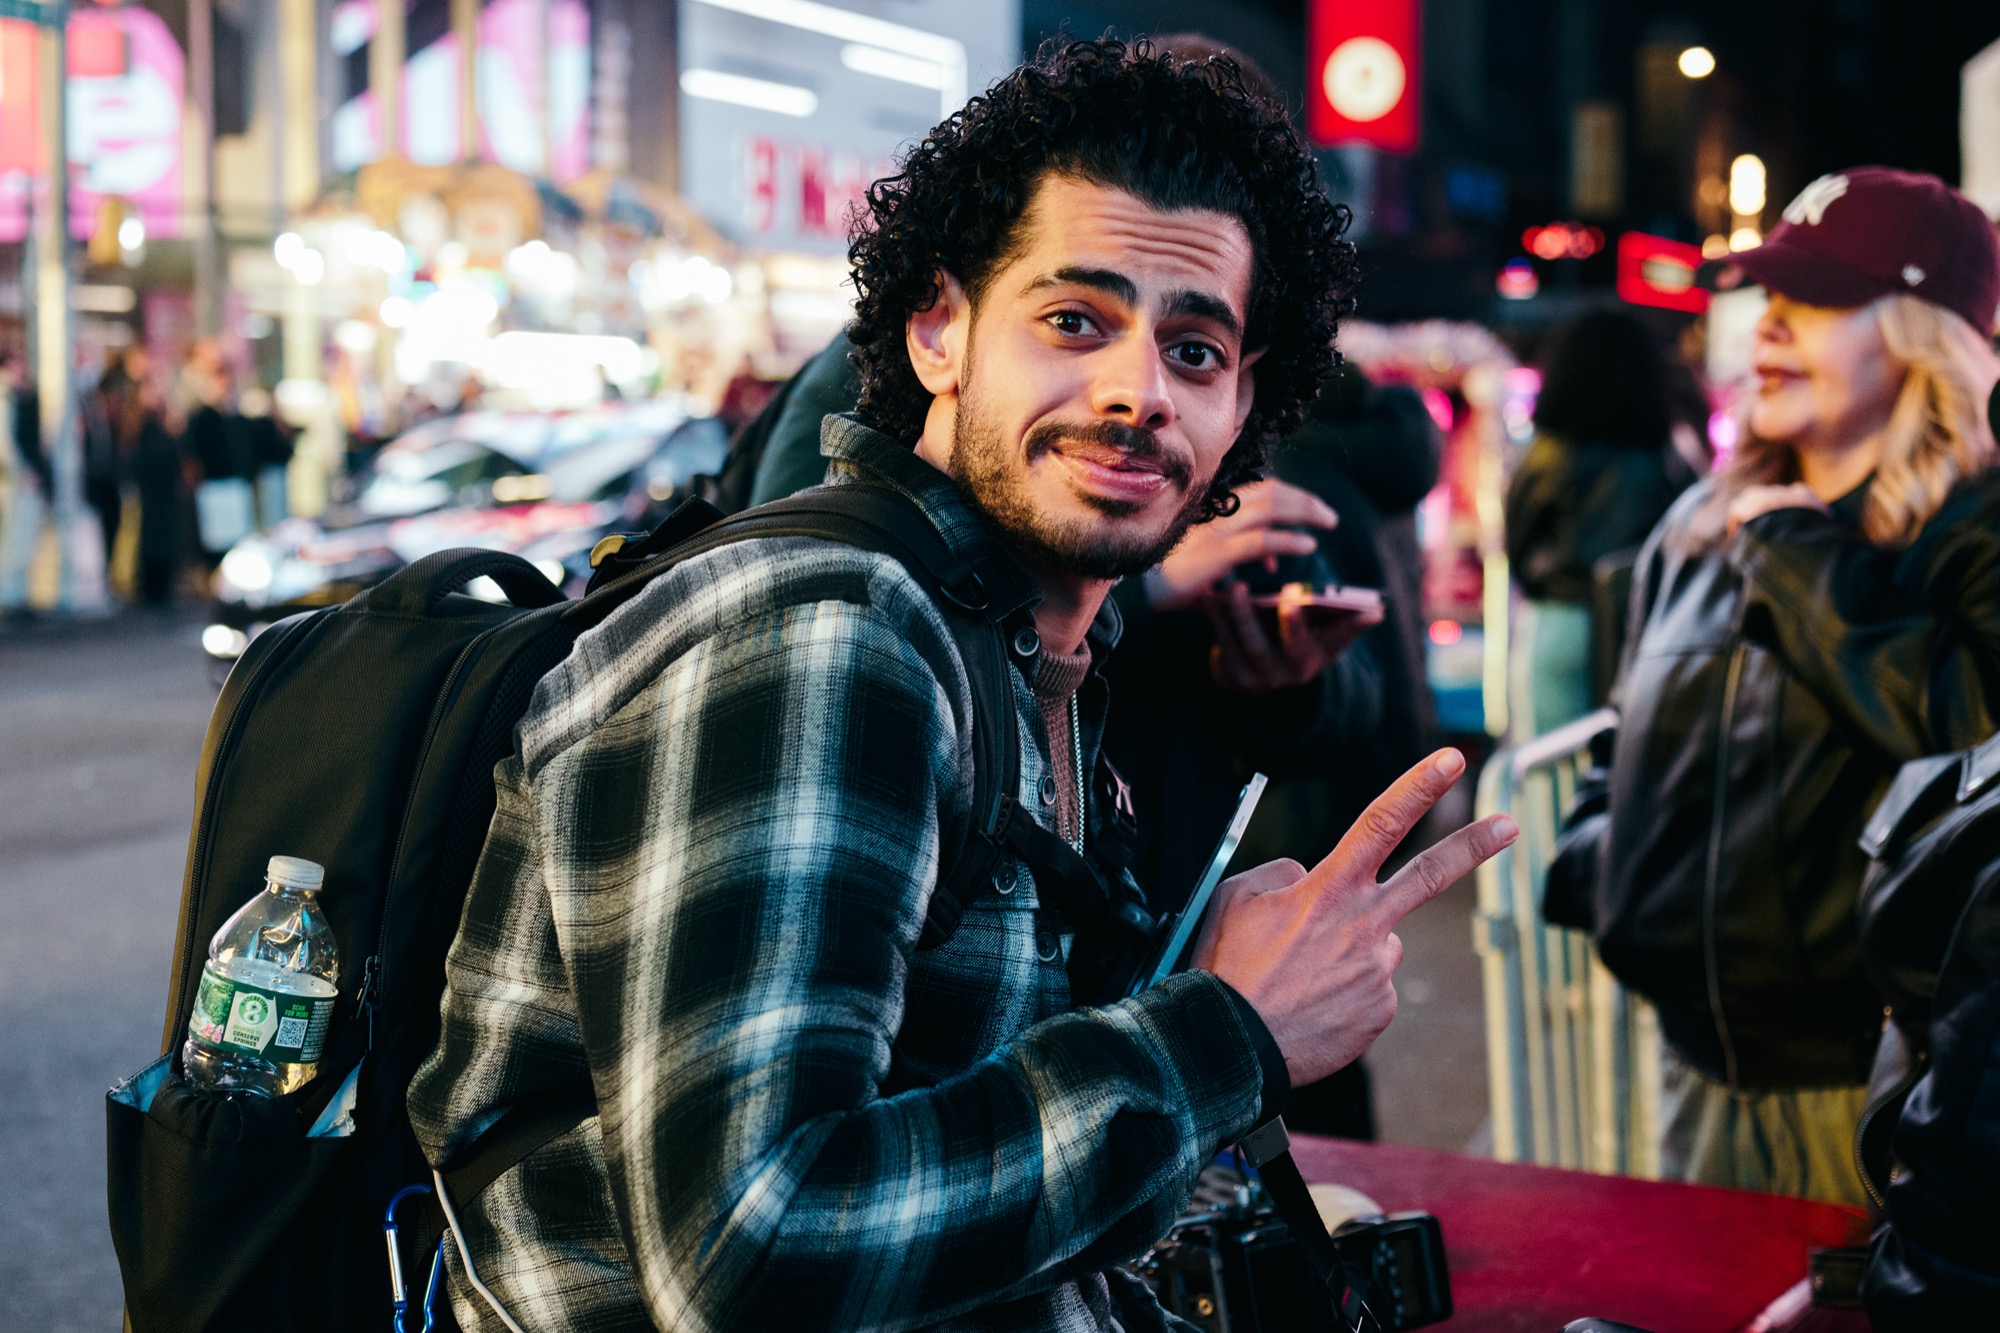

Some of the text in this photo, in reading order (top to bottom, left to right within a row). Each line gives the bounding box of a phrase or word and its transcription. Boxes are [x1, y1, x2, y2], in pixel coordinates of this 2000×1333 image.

[284, 1009, 296, 1017] FOR
[232, 1030, 261, 1042] CONSERVE
[233, 1036, 258, 1046] SPRINGS
